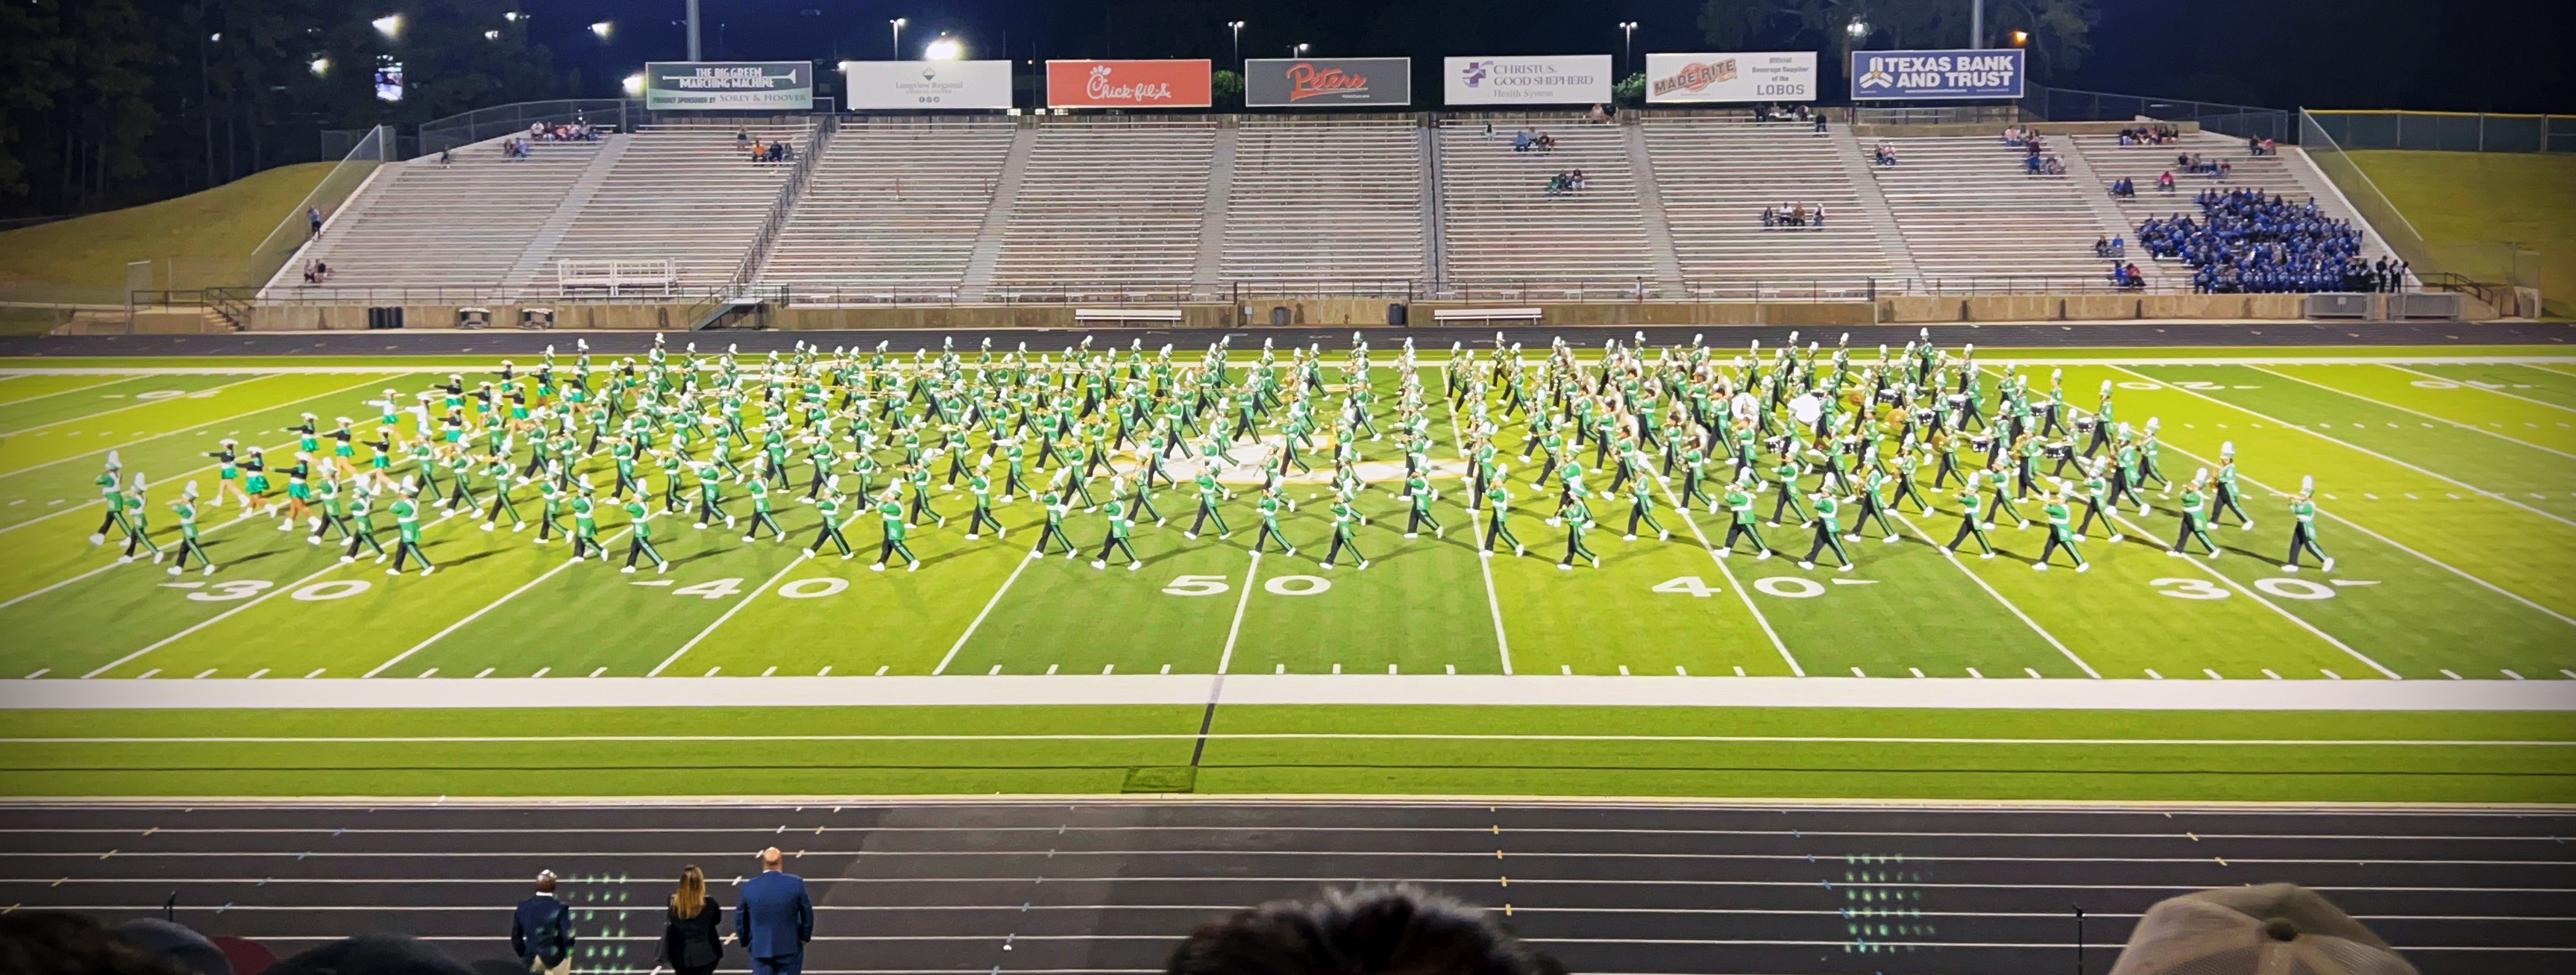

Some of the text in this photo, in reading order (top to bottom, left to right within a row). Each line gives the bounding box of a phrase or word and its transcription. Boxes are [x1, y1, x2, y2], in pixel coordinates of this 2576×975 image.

[1493, 64, 1555, 75] CHRISTUS
[1885, 56, 2014, 72] TEXAS BANK
[695, 67, 762, 78] THE BIG GREEN
[679, 76, 774, 88] MARCHING MACHINE
[1286, 63, 1369, 95] Peters
[1494, 76, 1594, 86] GOOD SHEPHERD
[1896, 72, 2014, 87] AND TRUST
[1087, 72, 1172, 101] Chick-fil-A
[1756, 84, 1805, 95] LOBOS
[753, 93, 761, 101] &
[764, 93, 806, 102] HOOVER
[1494, 90, 1554, 99] Health System
